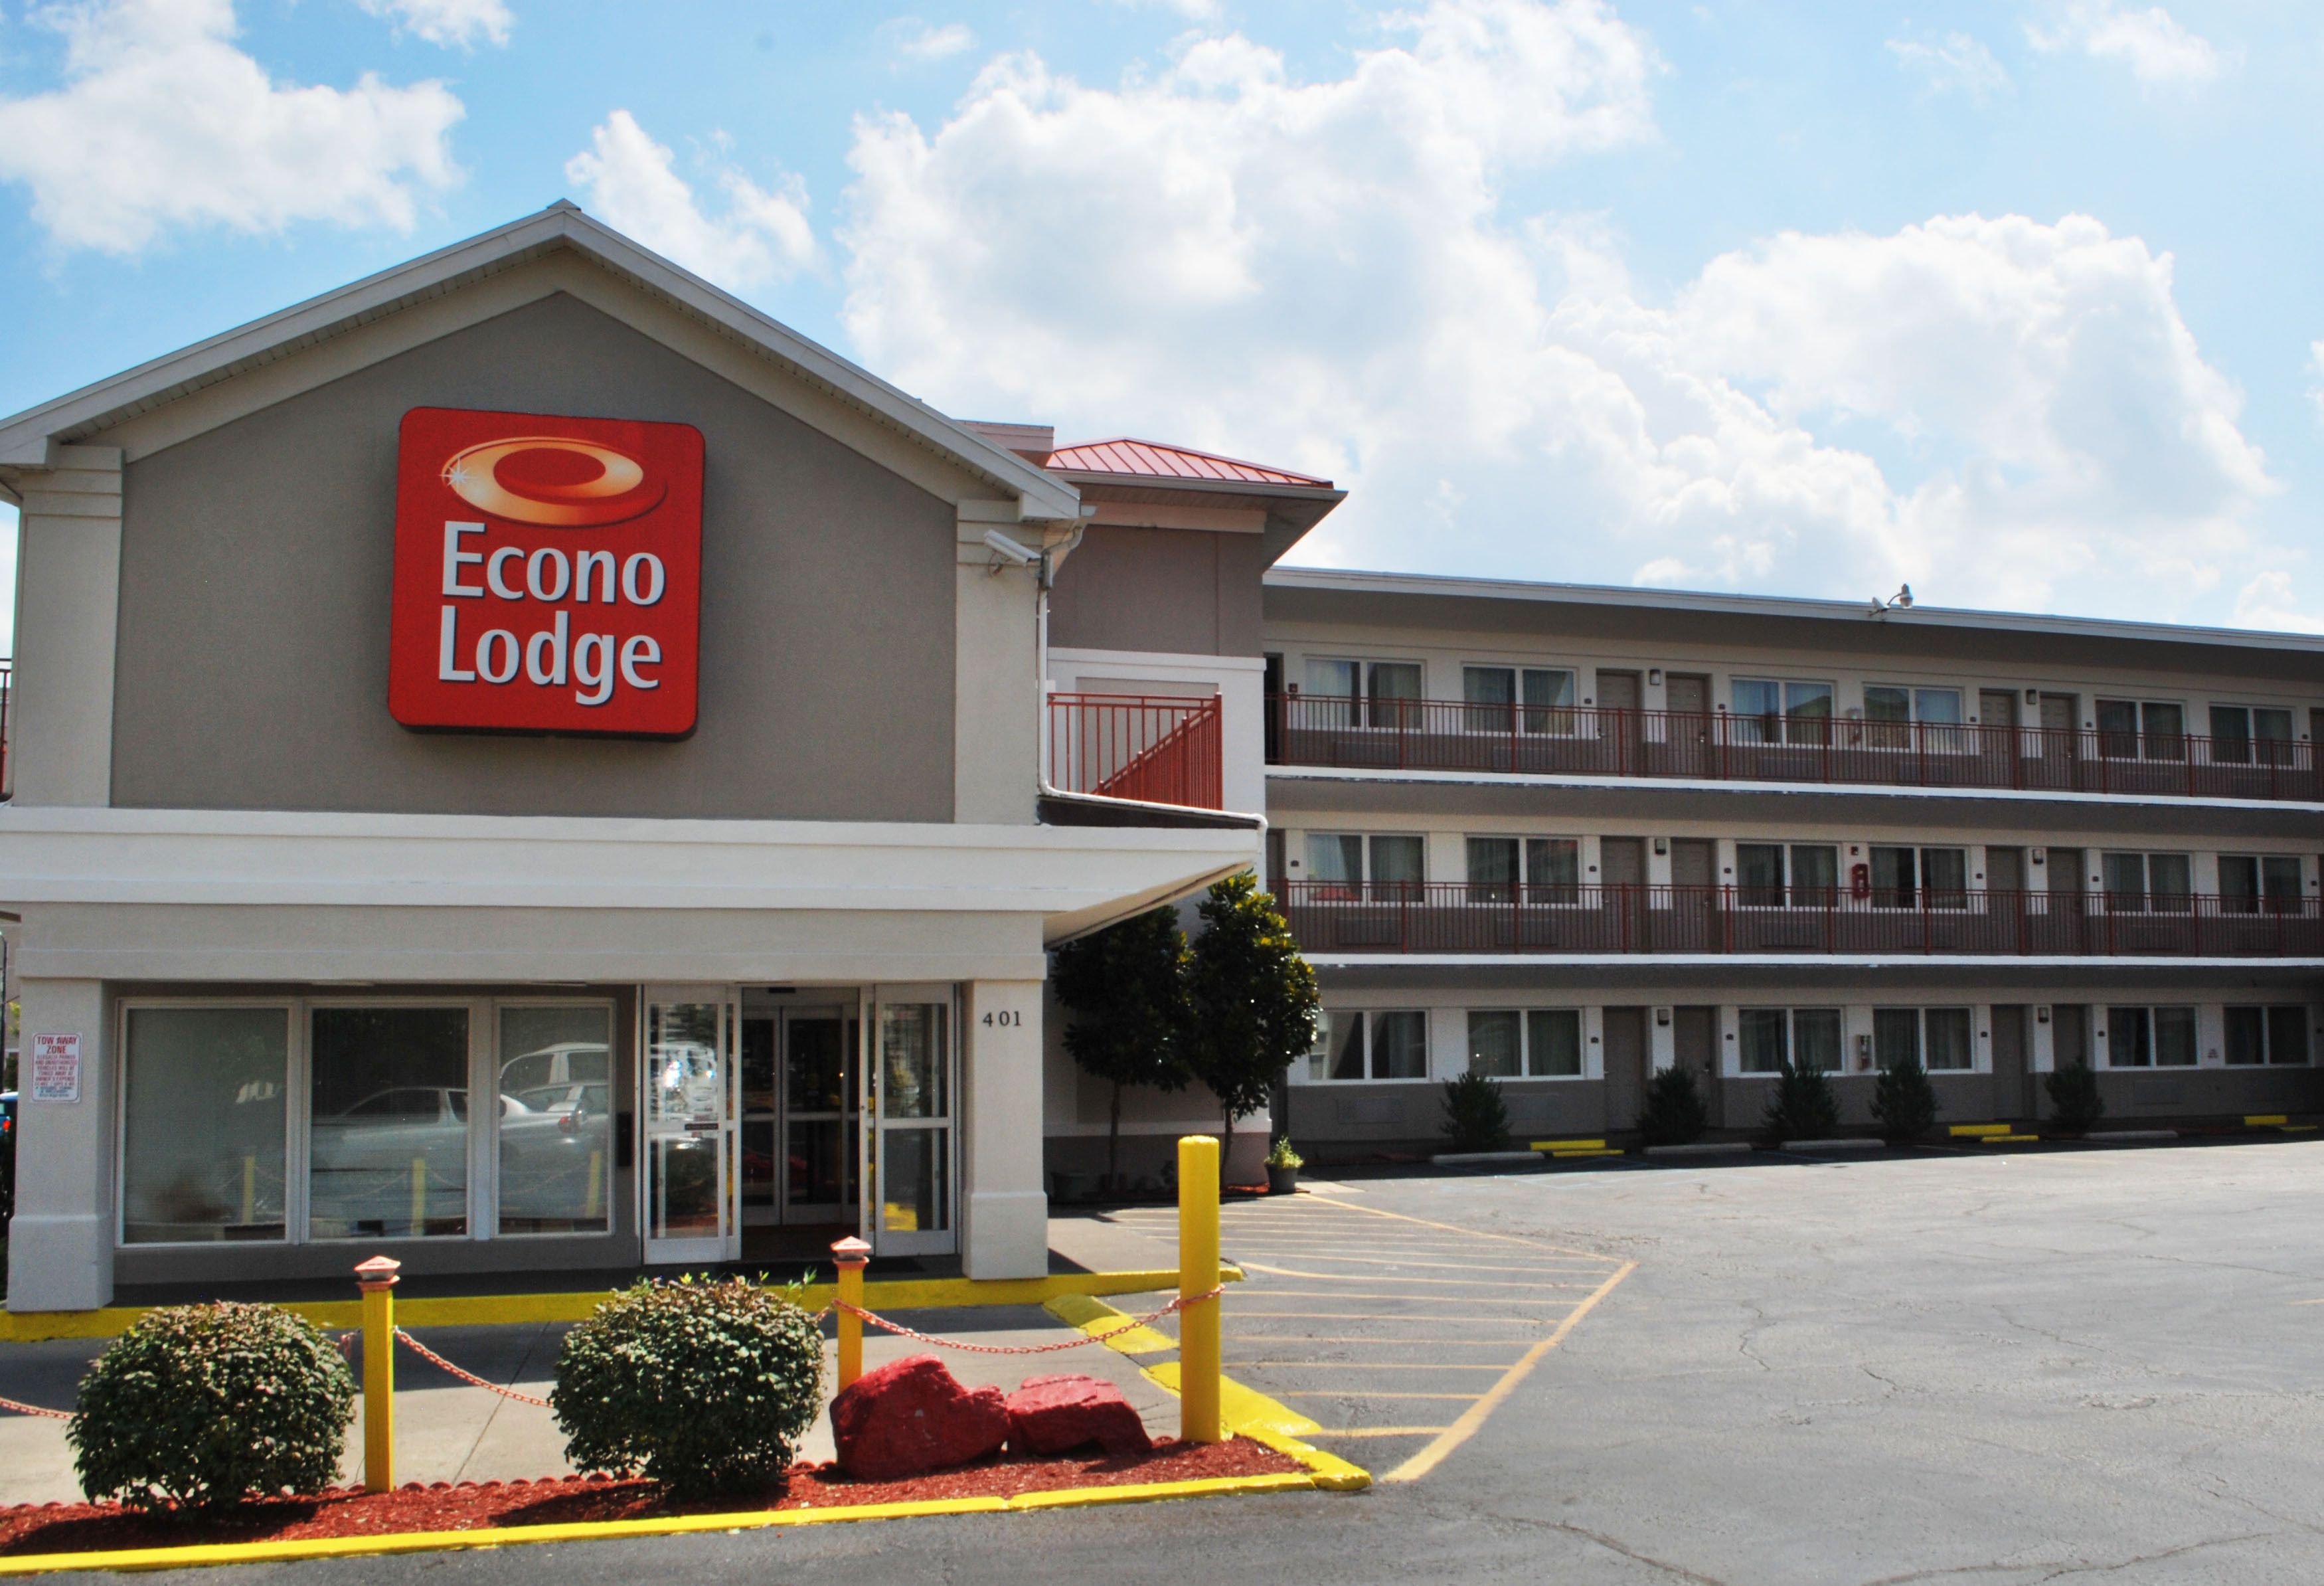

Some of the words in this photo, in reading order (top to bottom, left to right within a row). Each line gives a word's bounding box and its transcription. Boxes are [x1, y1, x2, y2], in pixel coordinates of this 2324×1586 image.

[442, 521, 665, 605] Econo
[439, 605, 661, 705] Lodge
[983, 1011, 1021, 1027] 401
[37, 1036, 54, 1045] TOW
[56, 1036, 77, 1045] AWAY
[46, 1045, 66, 1054] ZONE
